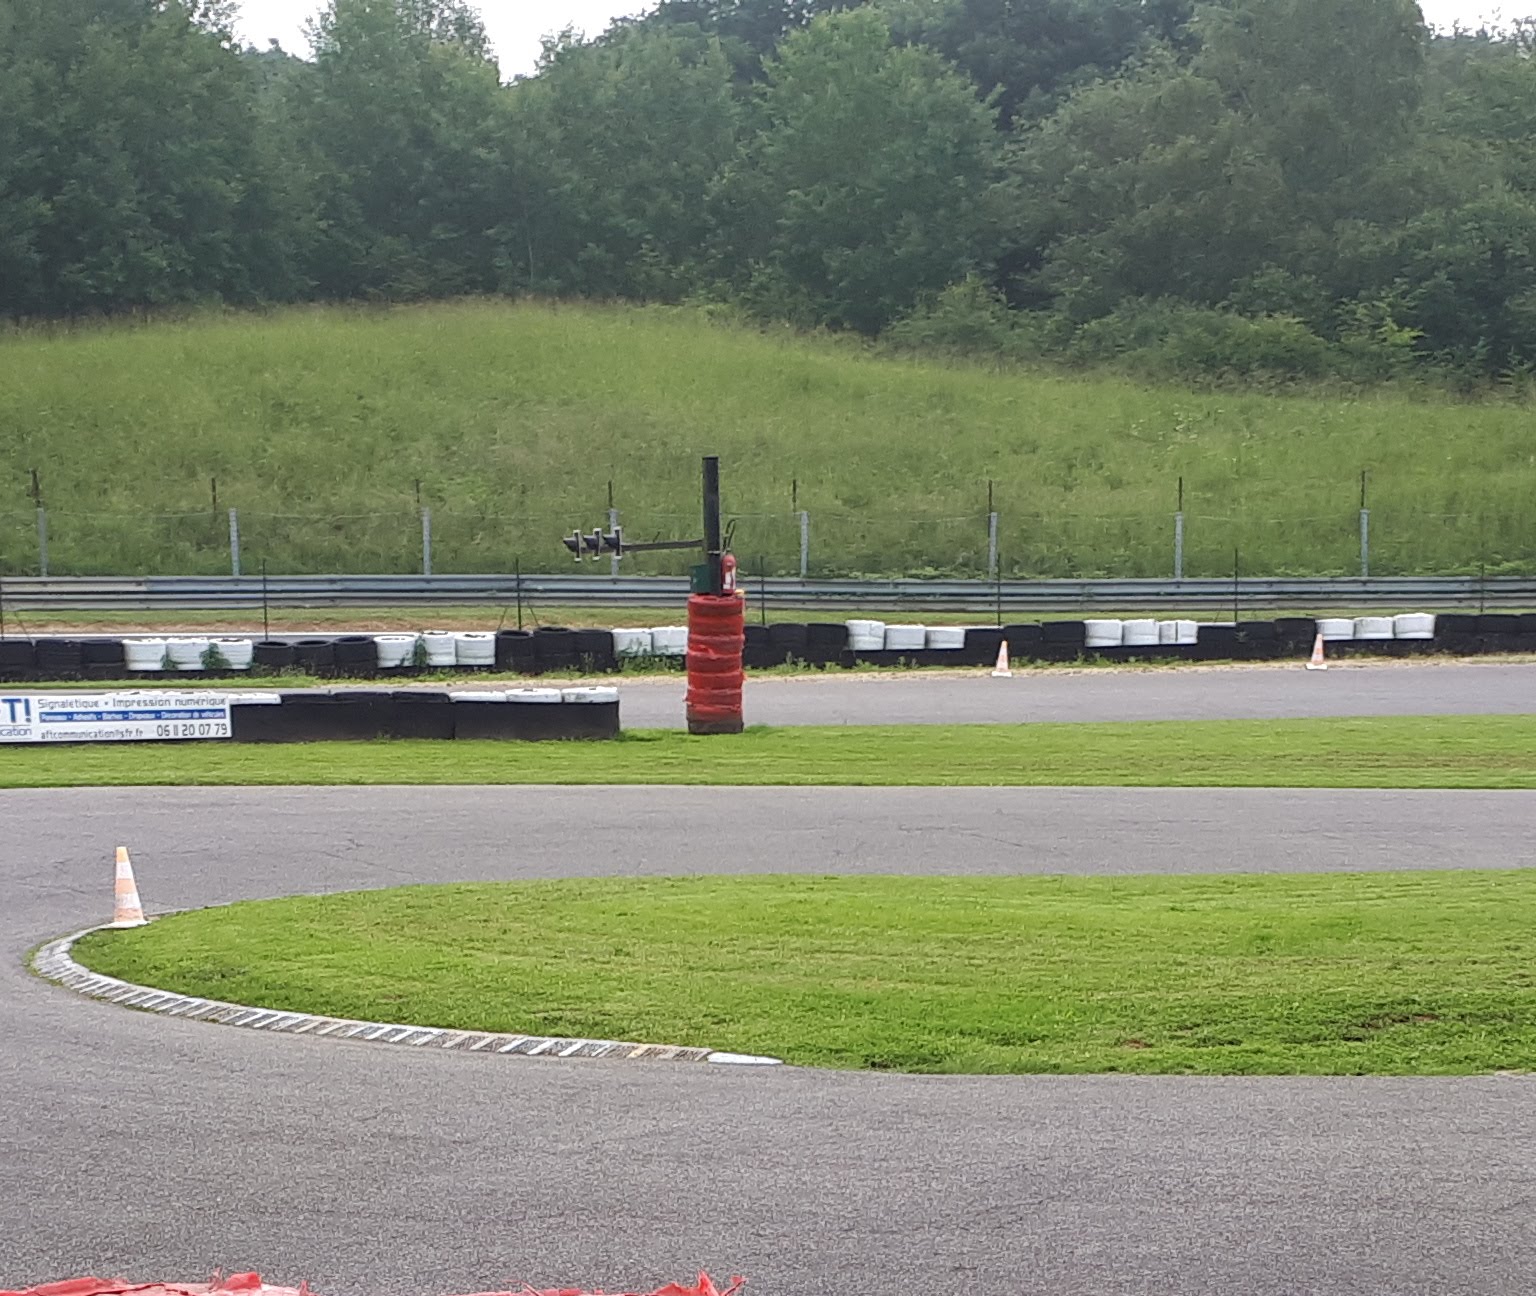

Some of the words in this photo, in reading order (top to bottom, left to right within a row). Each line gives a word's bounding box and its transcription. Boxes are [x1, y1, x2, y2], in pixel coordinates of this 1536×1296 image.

[112, 697, 171, 708] Impression
[181, 723, 195, 736] 20
[198, 723, 211, 736] 07
[214, 722, 227, 736] 79
